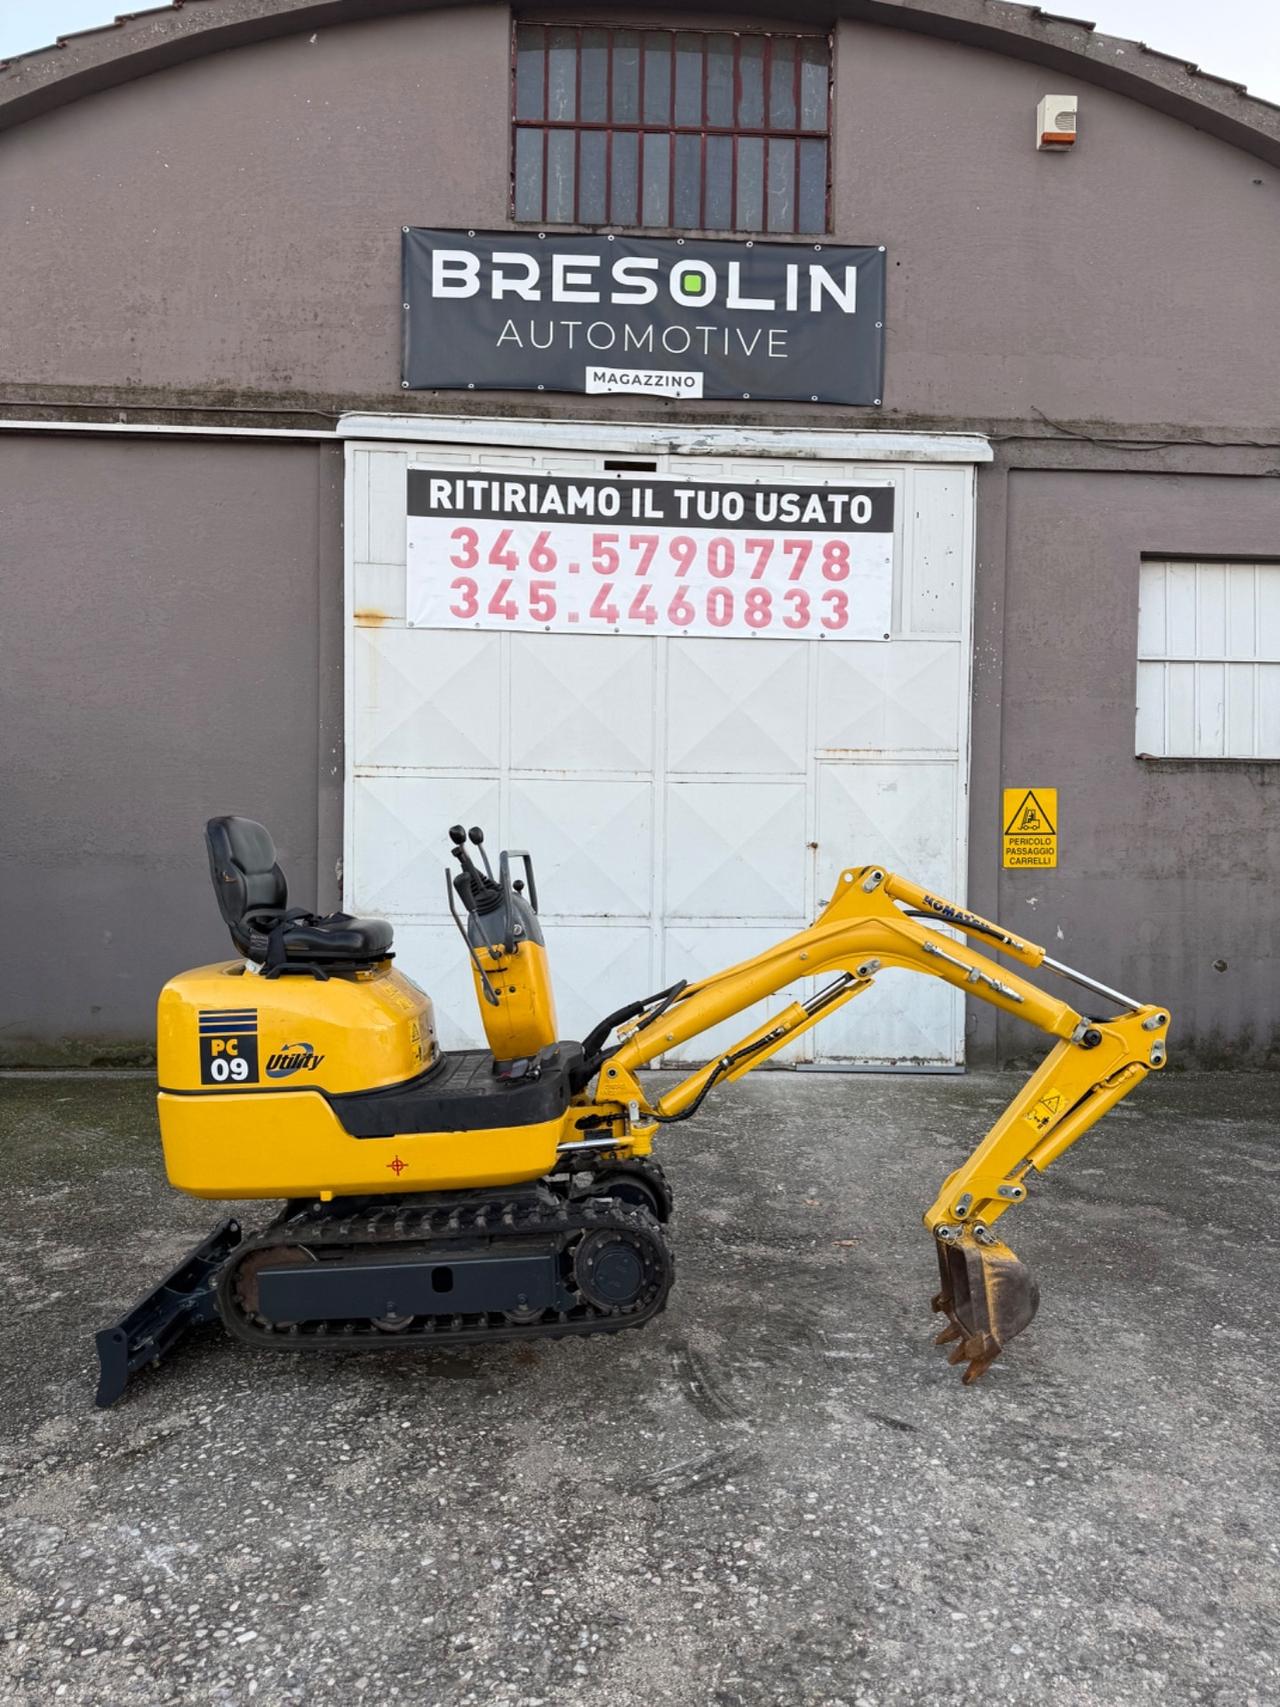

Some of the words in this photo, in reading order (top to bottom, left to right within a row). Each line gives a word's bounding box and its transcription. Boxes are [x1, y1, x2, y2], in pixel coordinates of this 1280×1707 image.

[432, 250, 857, 313] BRESOLIN
[496, 320, 788, 357] AUTOMOTIVE
[593, 371, 696, 388] MAGAZZINO
[430, 479, 621, 517] RITIRIAMO
[632, 488, 664, 518] IL
[674, 490, 745, 522] TUO
[756, 493, 873, 525] USATO
[450, 527, 850, 582] 346.5790778
[450, 576, 849, 629] 345.4460833
[1006, 847, 1054, 855] PASSAGGIO
[1009, 838, 1051, 846] PERICOLO
[1009, 857, 1051, 865] CARRELLI
[922, 895, 991, 928] KOMAT
[211, 1039, 239, 1056] PC
[211, 1058, 249, 1081] 09
[266, 1053, 325, 1071] Utility
